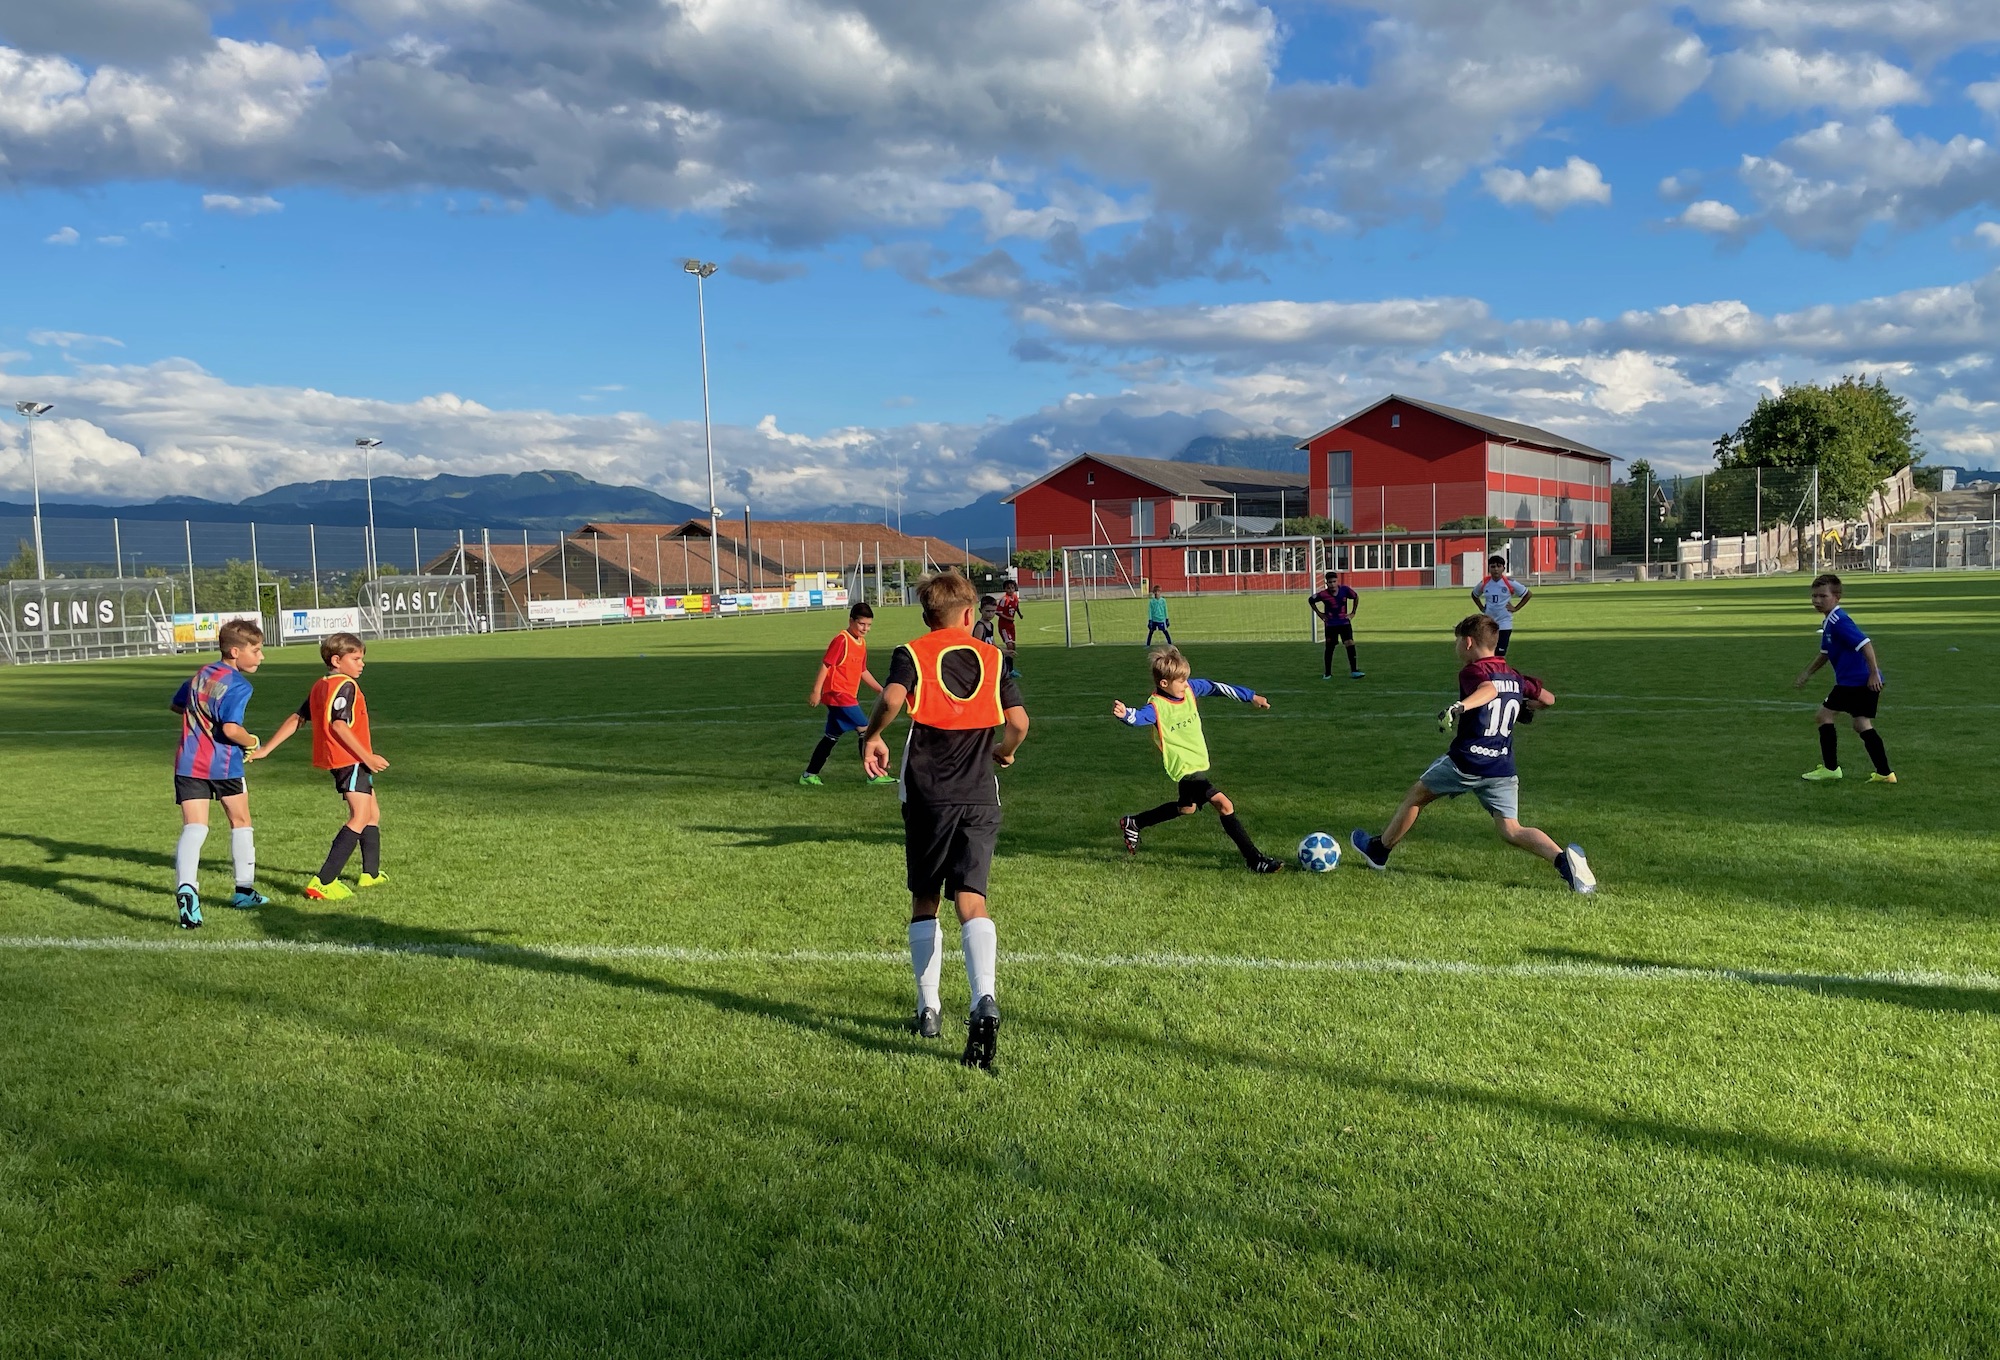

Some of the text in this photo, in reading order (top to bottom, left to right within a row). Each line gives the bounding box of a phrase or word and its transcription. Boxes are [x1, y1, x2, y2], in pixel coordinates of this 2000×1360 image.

[379, 592, 437, 611] GAST
[24, 600, 114, 626] SINS
[284, 614, 353, 629] VIGER tramaX
[195, 622, 215, 631] Landi
[1484, 698, 1520, 737] 10
[313, 883, 328, 894] FILA
